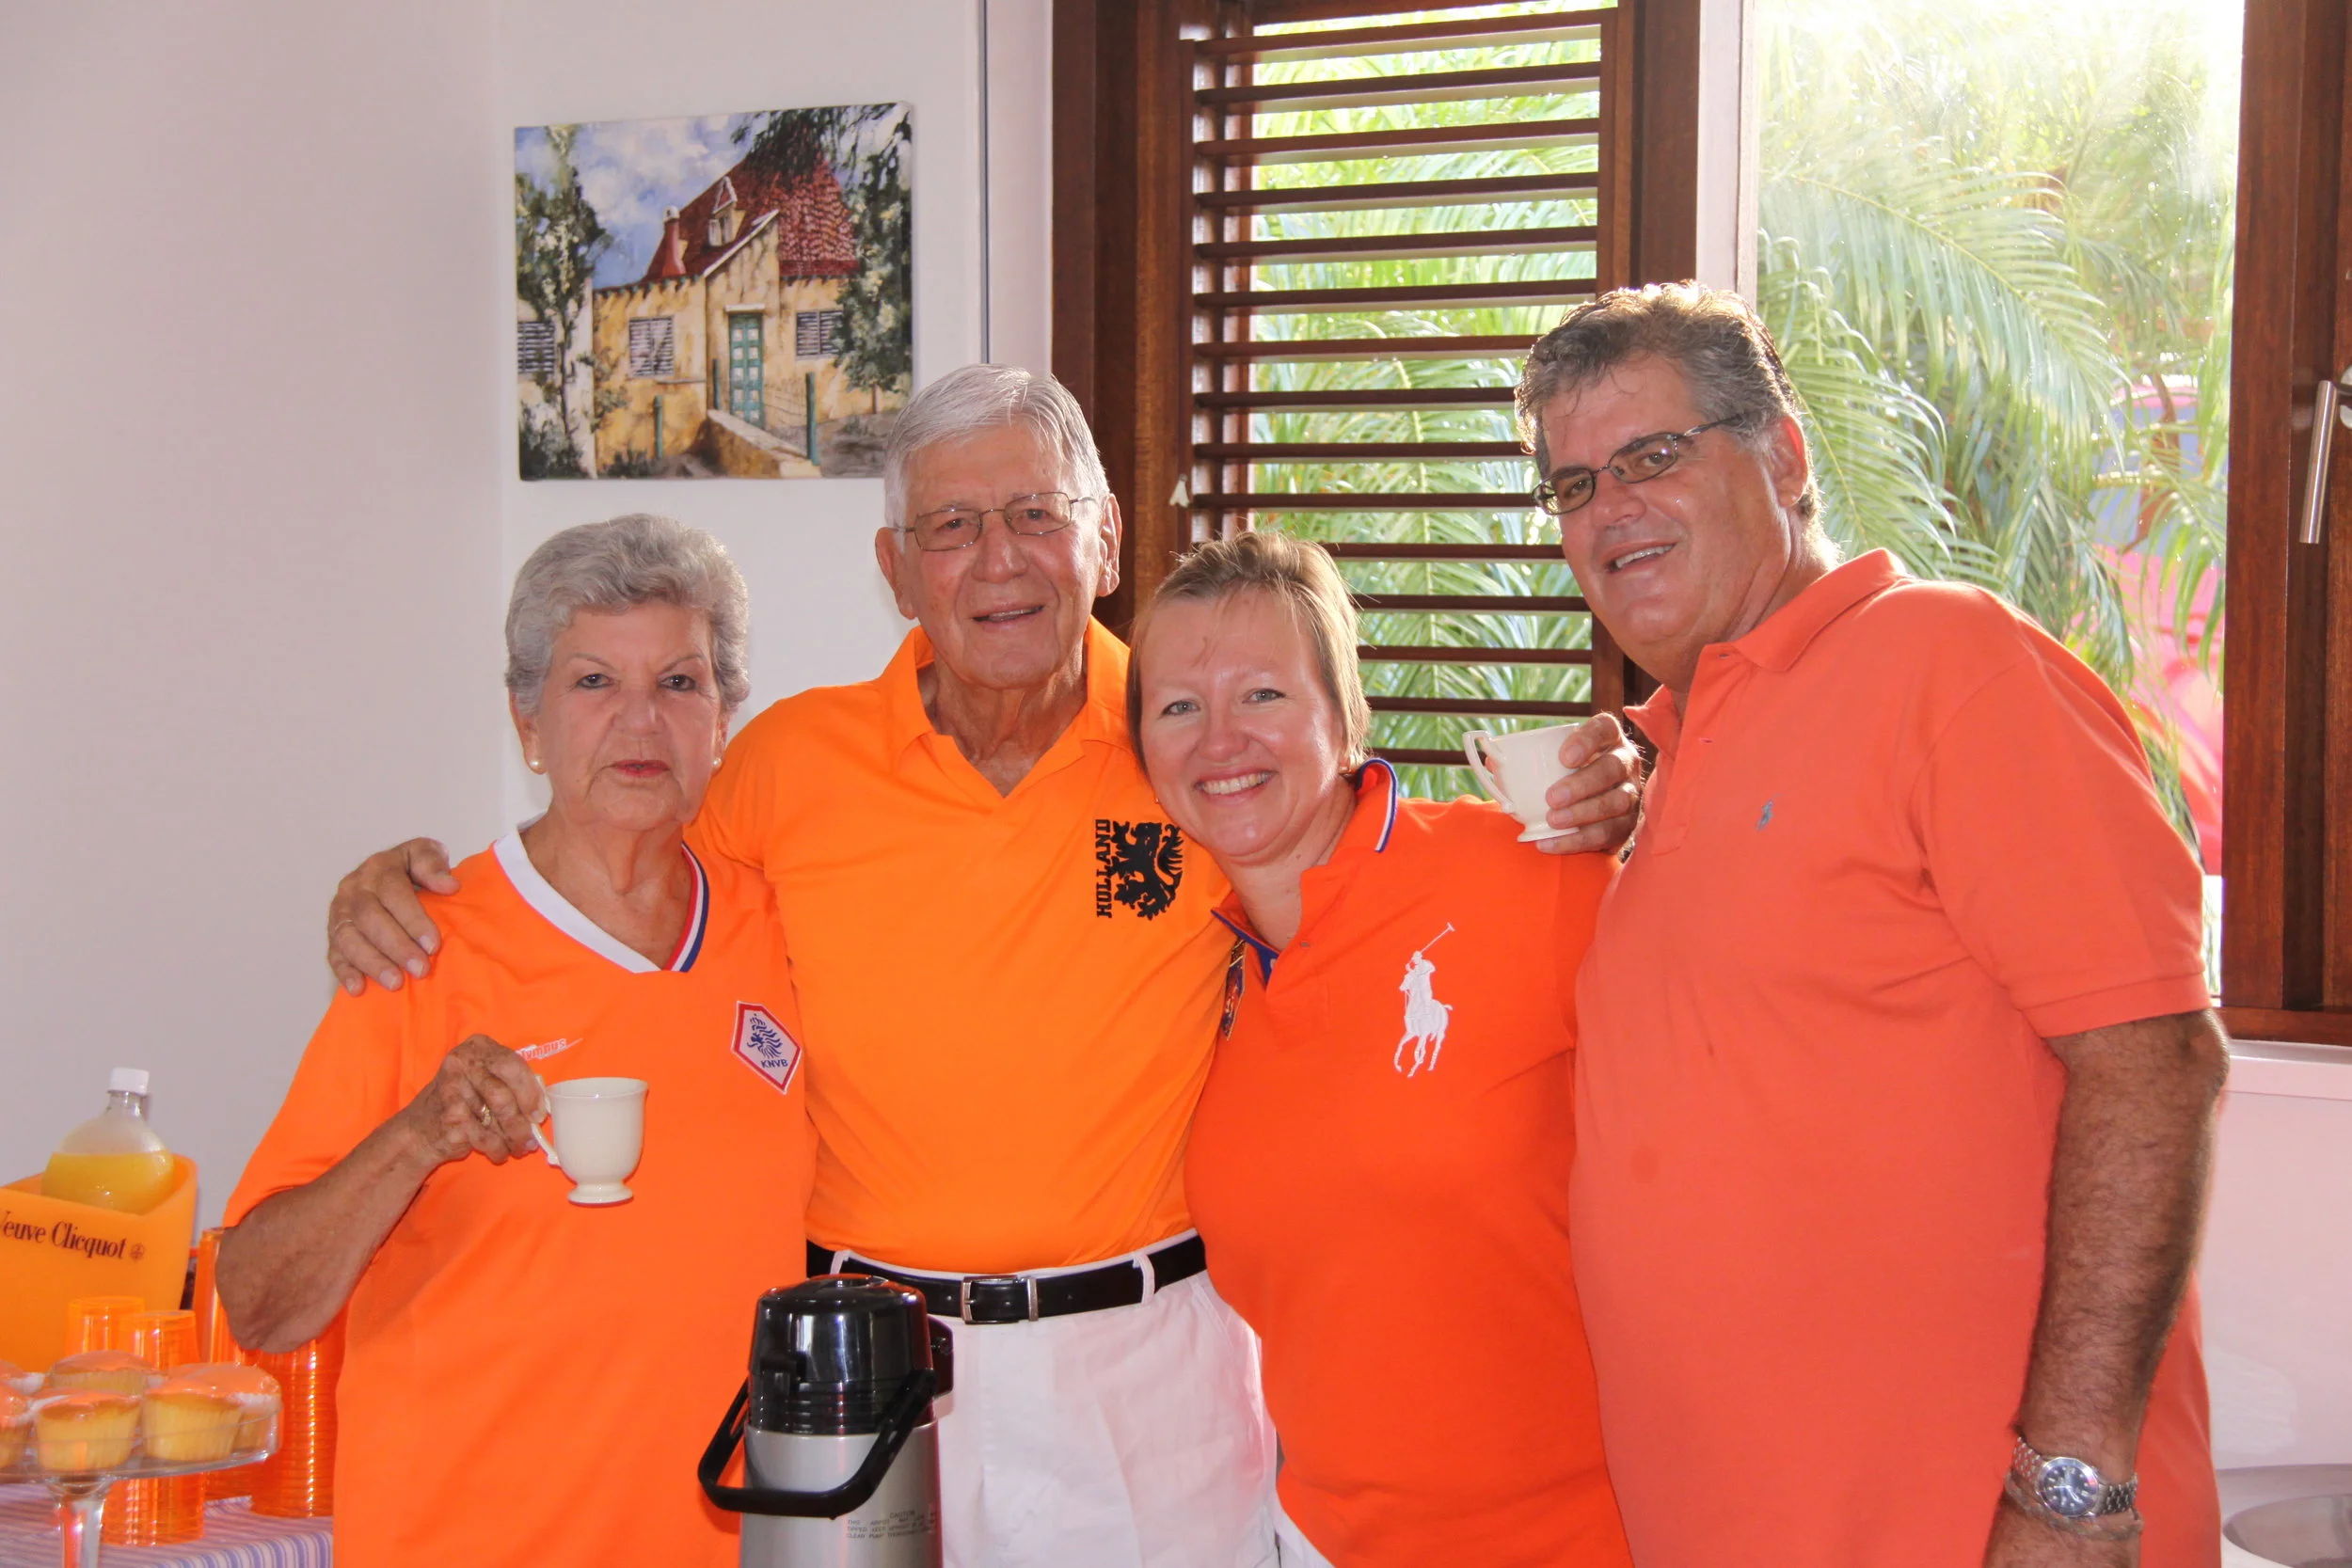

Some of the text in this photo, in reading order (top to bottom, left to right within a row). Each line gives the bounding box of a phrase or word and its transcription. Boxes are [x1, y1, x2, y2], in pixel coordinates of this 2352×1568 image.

[1095, 819, 1112, 918] HOLLAND
[760, 1058, 788, 1069] KNVB
[52, 1221, 127, 1259] Clicquot
